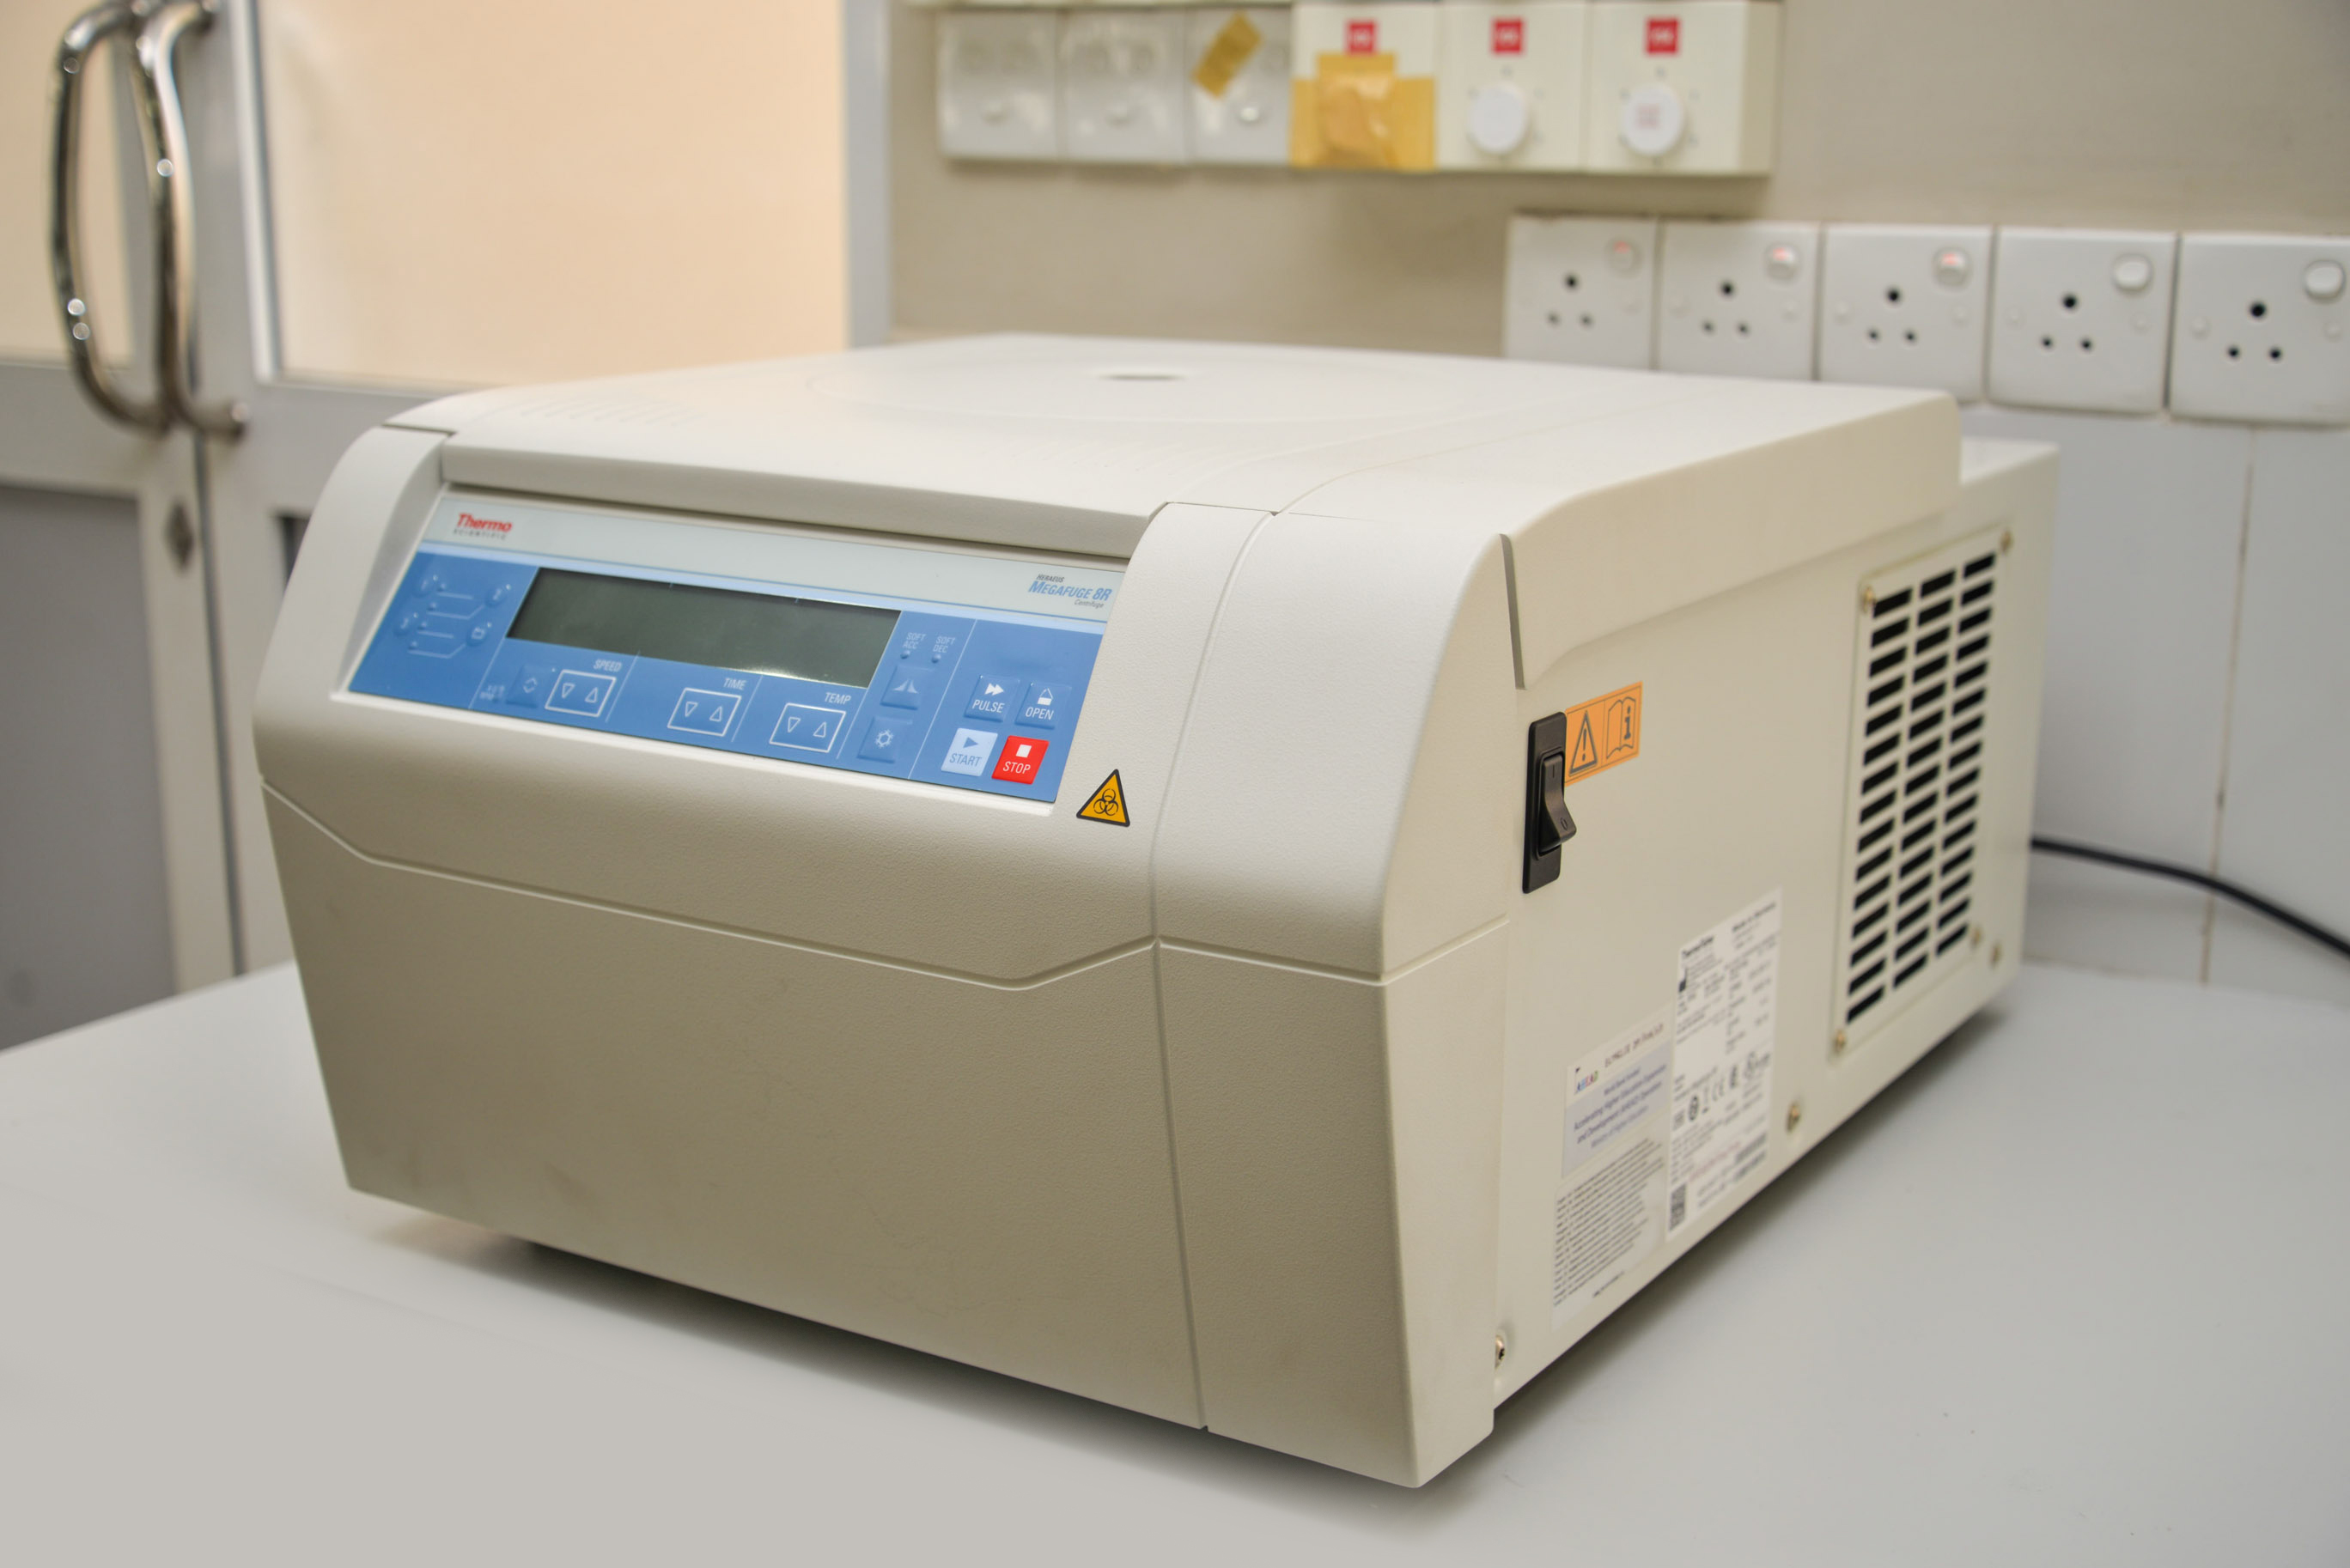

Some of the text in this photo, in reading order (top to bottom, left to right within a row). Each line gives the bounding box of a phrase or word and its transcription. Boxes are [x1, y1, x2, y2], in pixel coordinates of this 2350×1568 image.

[457, 513, 513, 532] Thermo
[1036, 574, 1065, 583] HERAEUS
[1029, 580, 1113, 601] MEGAFUGE 8R
[906, 632, 926, 641] SOFT
[935, 636, 956, 646] SOFT
[933, 644, 948, 653] DEC
[593, 659, 623, 672] SPEED
[723, 678, 746, 690] TIME
[825, 692, 851, 705] TEMP
[971, 699, 1005, 714] PULSE
[1025, 707, 1055, 720] OPEN
[949, 752, 983, 767] START
[1002, 761, 1031, 775] STOP
